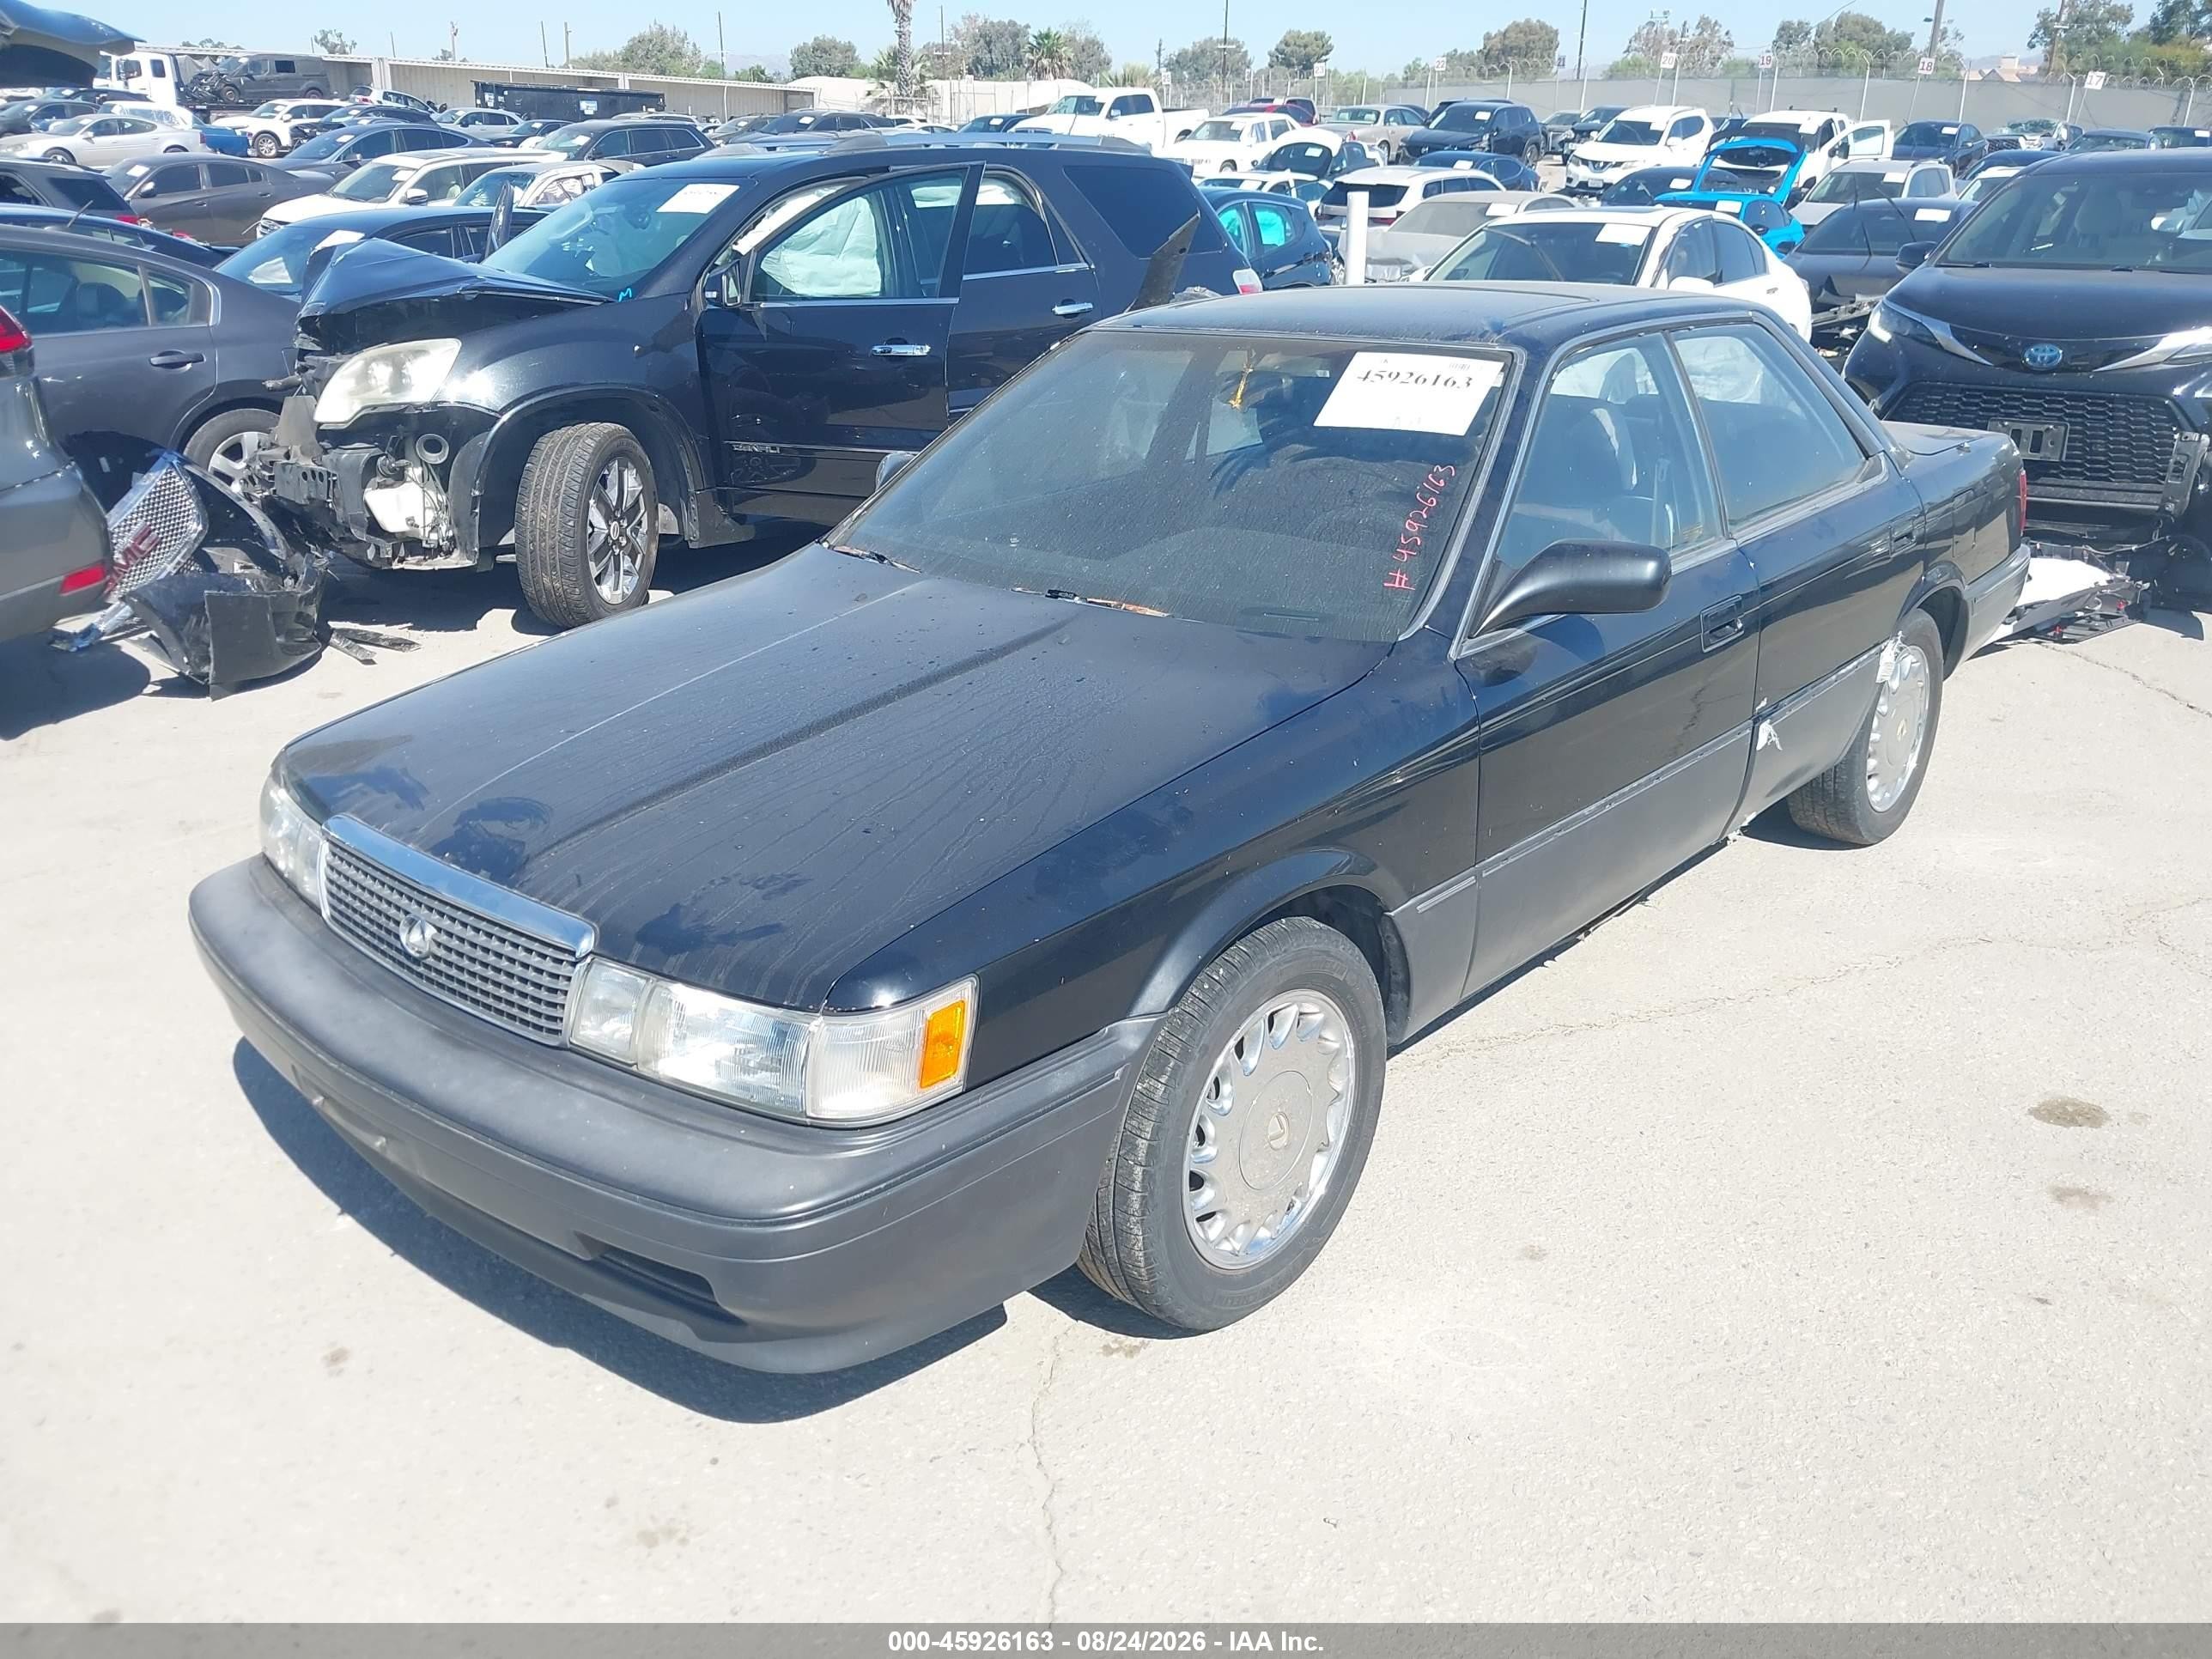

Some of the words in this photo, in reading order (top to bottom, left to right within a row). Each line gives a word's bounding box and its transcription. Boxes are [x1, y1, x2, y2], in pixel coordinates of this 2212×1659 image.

[1435, 60, 1444, 69] 22
[1662, 56, 1674, 65] 20
[1760, 55, 1771, 65] 19
[1315, 65, 1324, 75] 23
[1919, 61, 1932, 70] 18
[2087, 75, 2103, 85] 17
[1356, 369, 1474, 390] 45926163
[1392, 464, 1455, 563] 45926163
